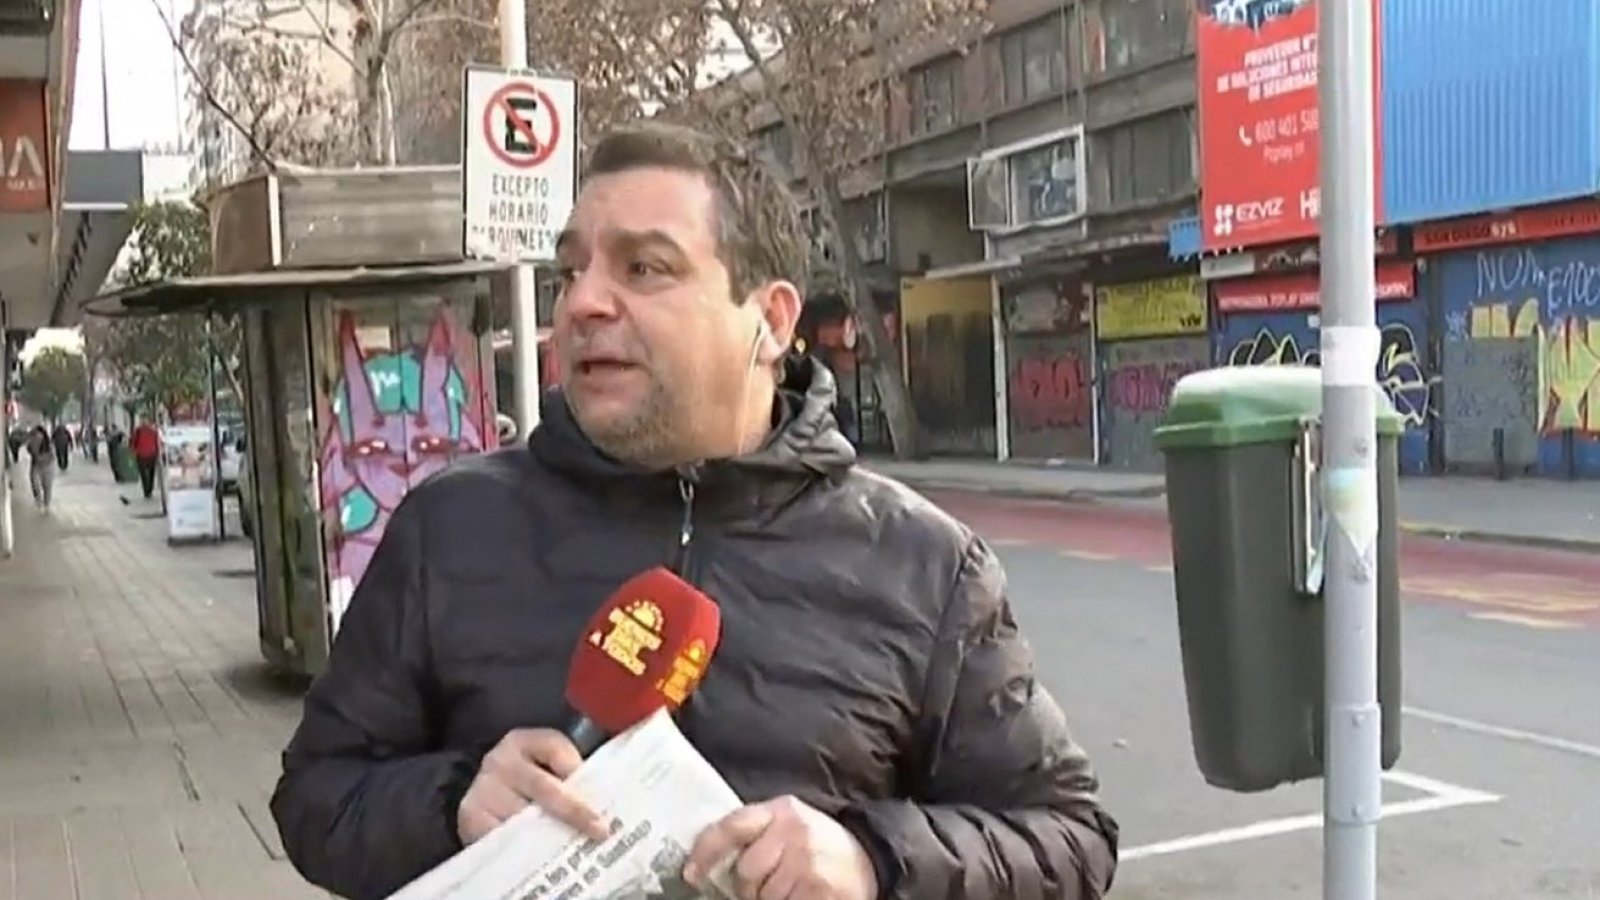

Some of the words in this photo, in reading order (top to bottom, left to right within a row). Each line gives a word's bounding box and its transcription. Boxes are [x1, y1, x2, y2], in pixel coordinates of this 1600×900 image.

[492, 173, 550, 198] EXCEPTO
[488, 201, 549, 227] HORARIO
[1236, 197, 1284, 221] EZVIZ
[597, 819, 652, 868] Santiago
